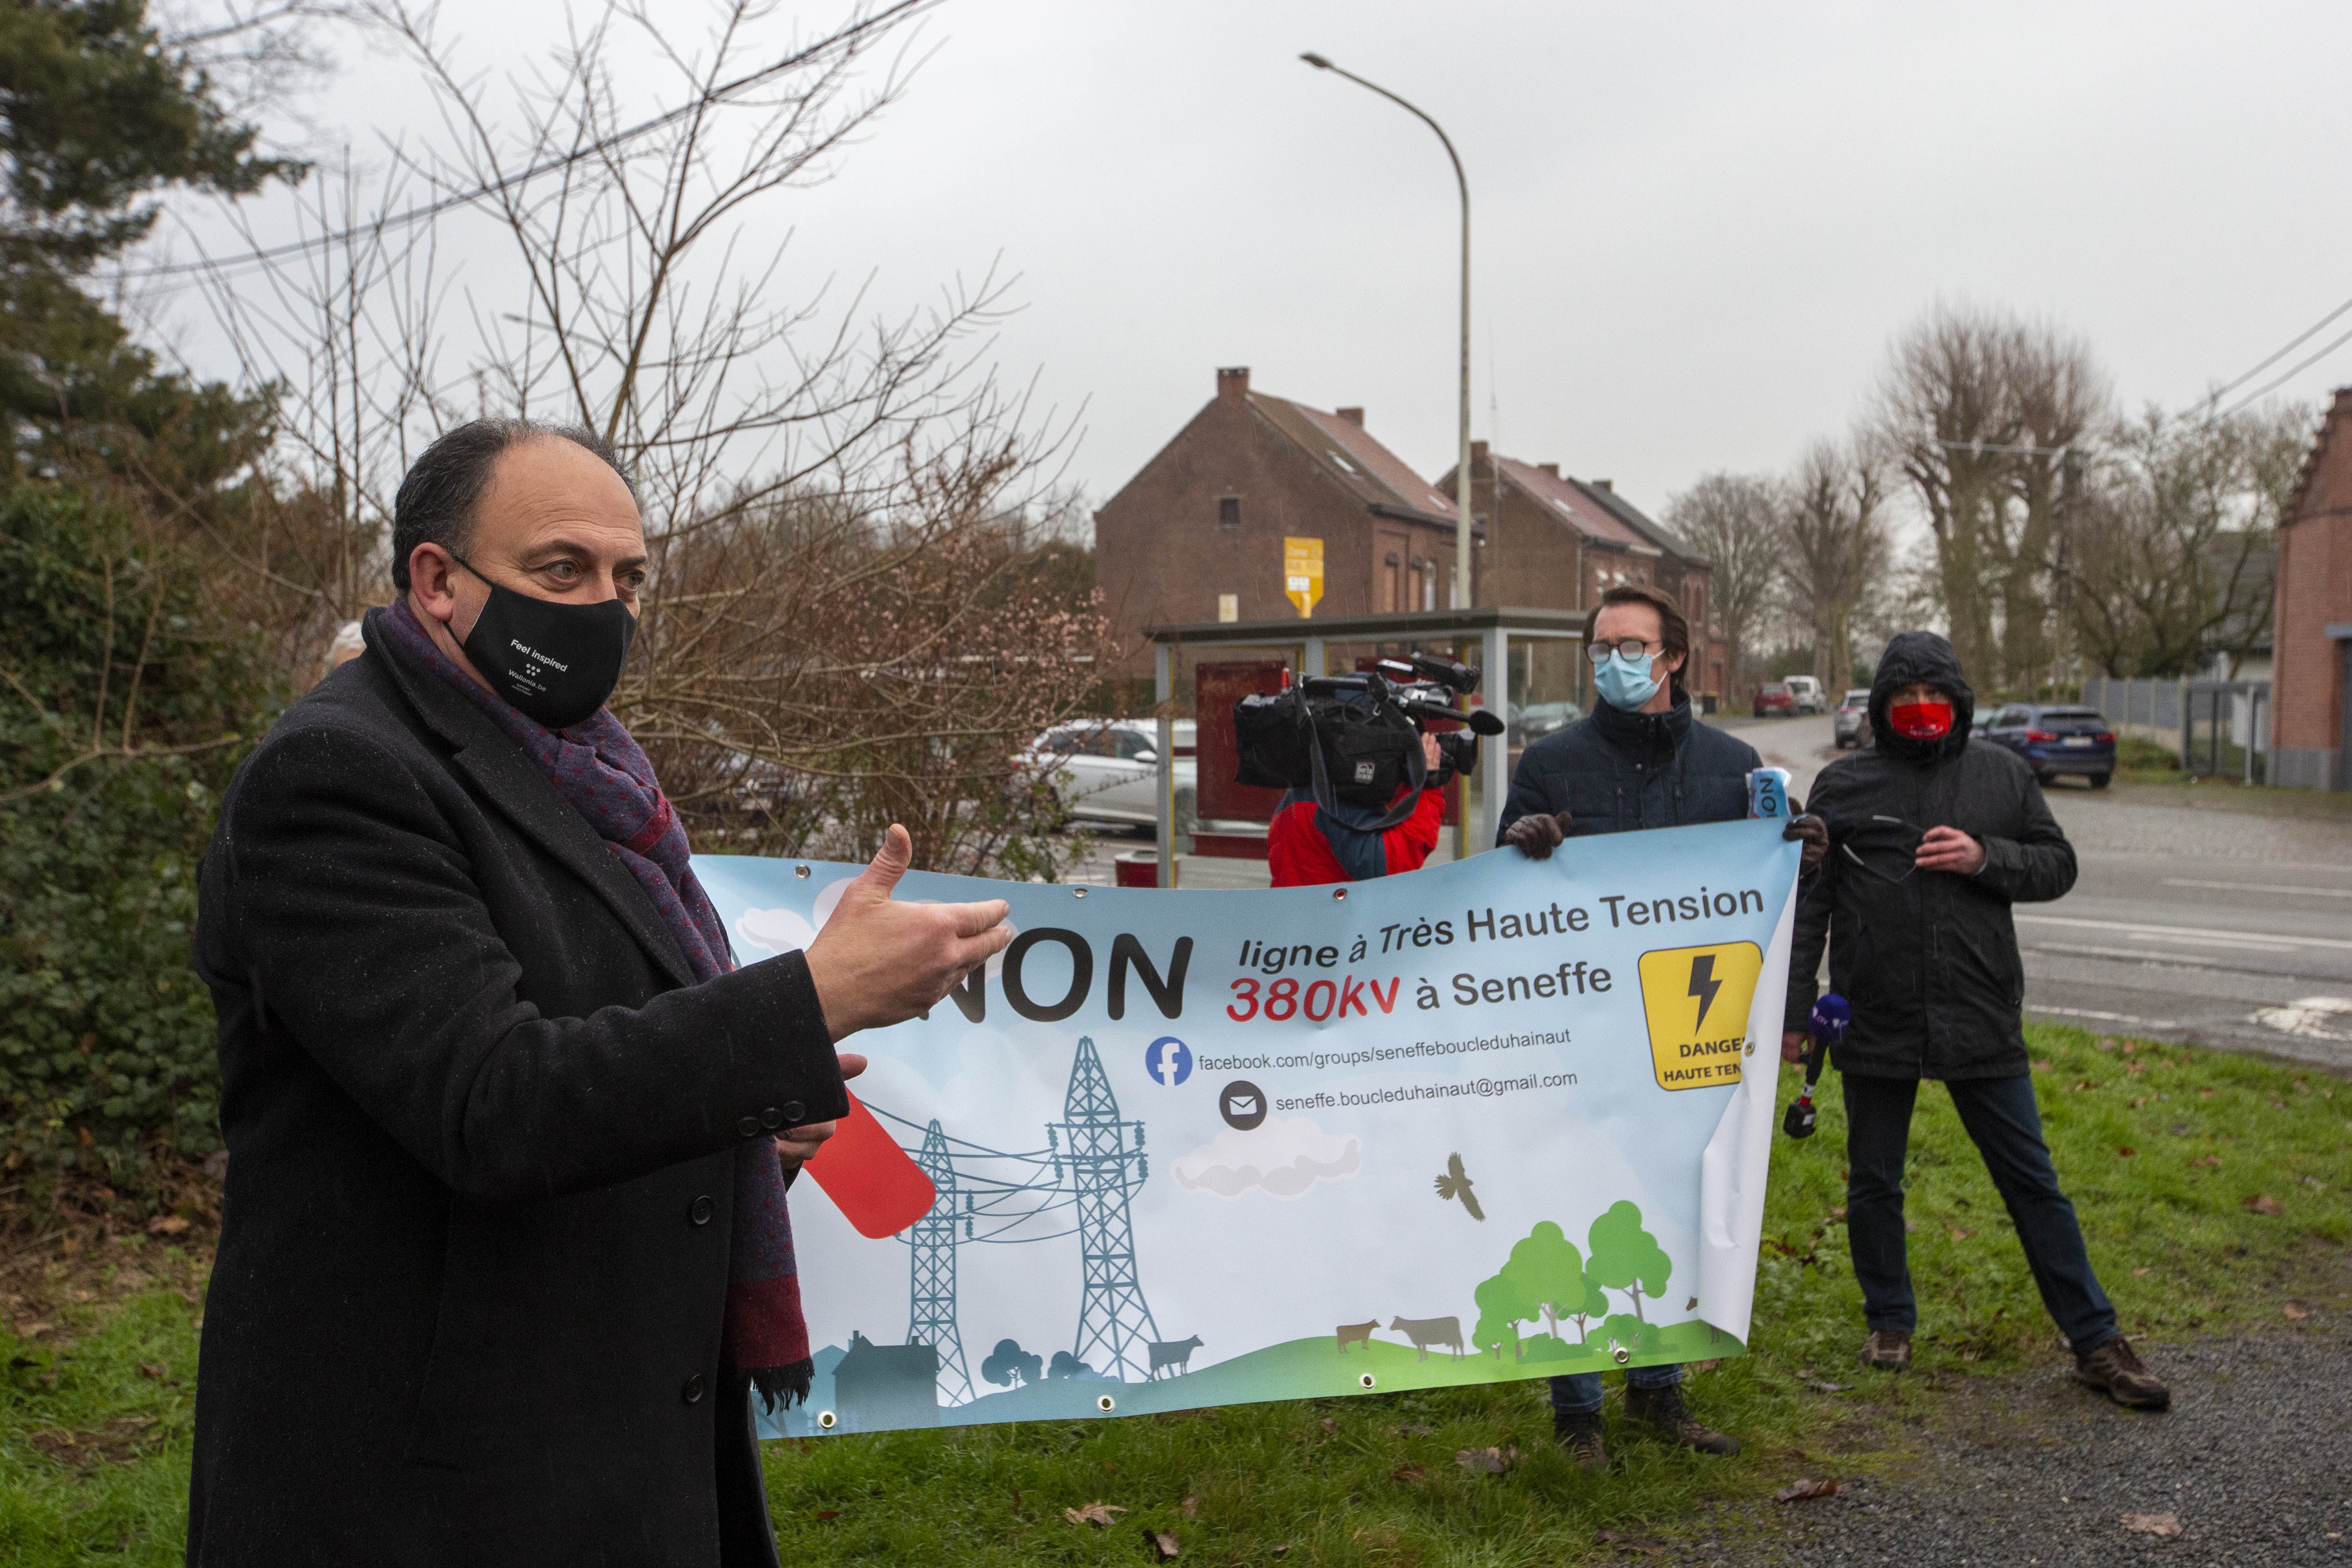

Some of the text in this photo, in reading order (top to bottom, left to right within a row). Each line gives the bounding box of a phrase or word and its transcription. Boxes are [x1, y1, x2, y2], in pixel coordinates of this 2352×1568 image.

[510, 639, 568, 672] Feel inspired
[509, 669, 546, 691] Wallonia.be
[1759, 777, 1778, 818] ON
[1239, 886, 1764, 975] ligne à Très Haute Tension
[1416, 977, 1441, 1010] à
[1452, 960, 1612, 1006] Seneffe
[1199, 1028, 1571, 1070] facebook.com/groups/seneffeboucleduhainaut
[1680, 1037, 1746, 1058] DANGE
[1664, 1063, 1742, 1082] HAUTE TEN
[1276, 1073, 1578, 1111] seneffe.boucleduhainaut@gmail.com
